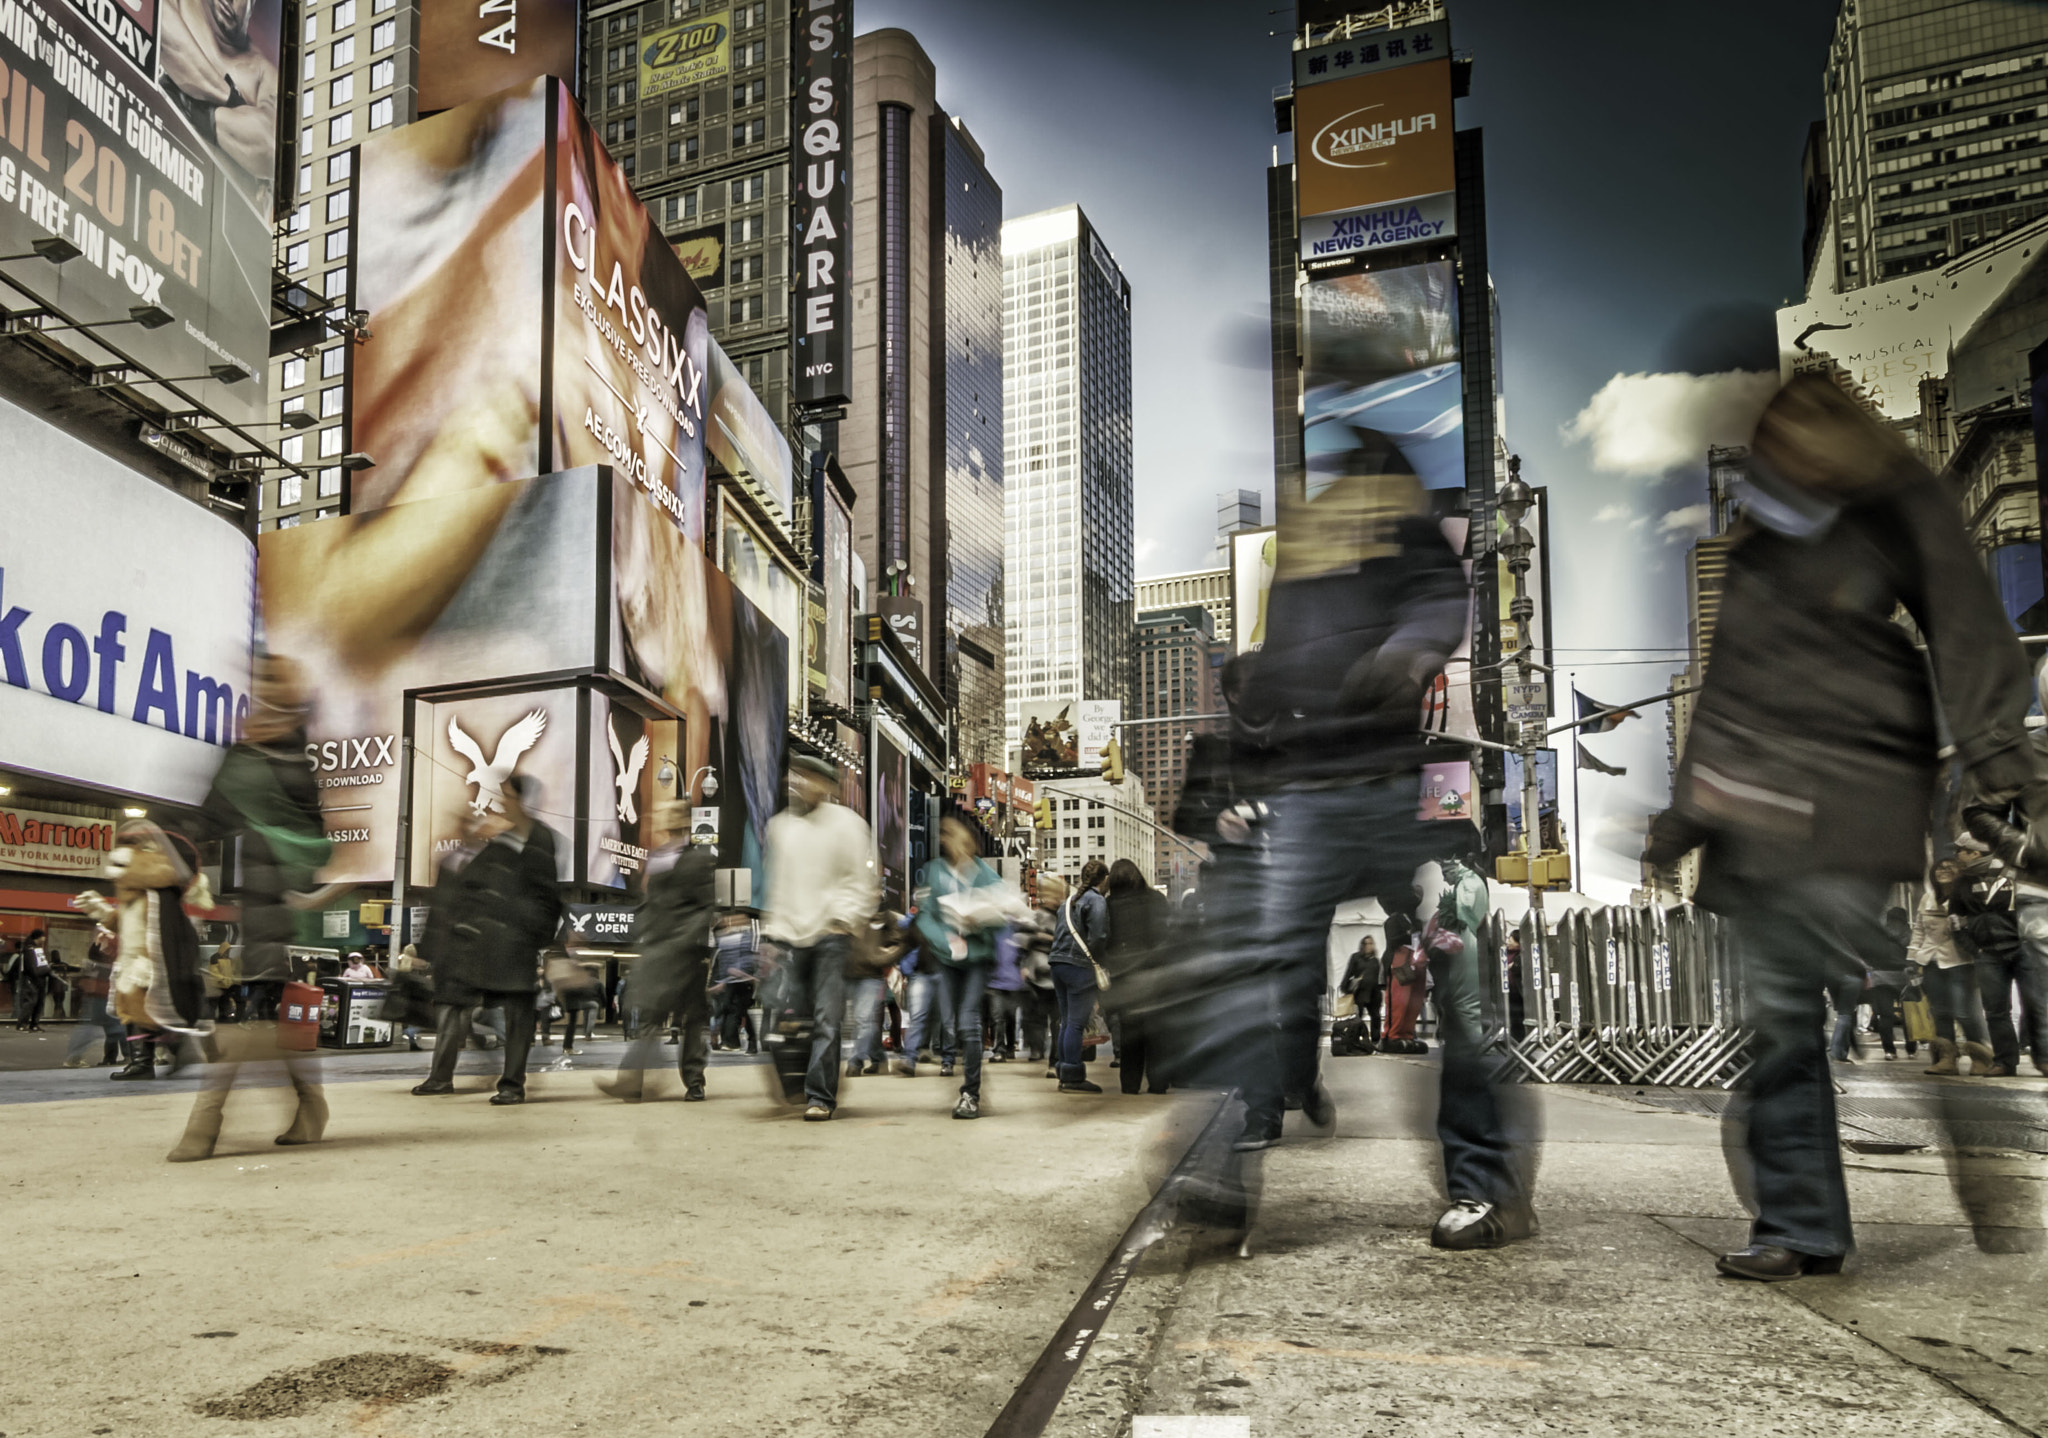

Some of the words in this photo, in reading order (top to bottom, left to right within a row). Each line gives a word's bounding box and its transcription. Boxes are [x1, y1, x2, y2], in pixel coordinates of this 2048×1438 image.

[651, 23, 720, 69] Z100
[1308, 33, 1434, 75] 新华通讯社
[105, 70, 163, 131] BATTLE
[53, 41, 121, 136] DANIEL
[126, 107, 204, 207] CORMIER
[1329, 113, 1436, 149] XINHUA
[64, 119, 126, 227] 20
[148, 188, 201, 288] 8ET
[803, 77, 840, 335] SQUARE
[1331, 205, 1423, 237] XINHUA
[20, 170, 69, 237] FREE
[107, 237, 164, 304] FOX
[1313, 235, 1364, 255] NEWS
[1369, 220, 1444, 244] AGENCY
[564, 202, 701, 420] CLASSIXX
[574, 283, 627, 359] EXCLUSIVE
[627, 347, 649, 387] FREE
[650, 379, 695, 438] DOWNLOAD
[1849, 337, 1934, 363] MUSICAL
[805, 362, 833, 377] NYC
[1861, 352, 1935, 384] BEST
[584, 406, 685, 523] AE.COM/CLASSIXX
[42, 611, 127, 715] of
[1513, 685, 1542, 694] NYPD
[1094, 705, 1104, 715] By
[1508, 704, 1546, 712] SECURITY
[1511, 711, 1545, 720] CAMERA
[1088, 732, 1100, 741] did
[326, 774, 383, 788] DOWNLOAD
[0, 811, 113, 851] Marriott
[600, 837, 631, 856] AMERICAN
[631, 845, 649, 860] EAGLE
[20, 850, 49, 861] YORK
[52, 853, 101, 866] MARQUIS
[610, 854, 639, 870] OUTFITTERS
[595, 923, 629, 934] OPEN
[596, 912, 635, 924] WE'RE
[1501, 948, 1509, 990] NYPD
[1663, 944, 1671, 987] NYPD
